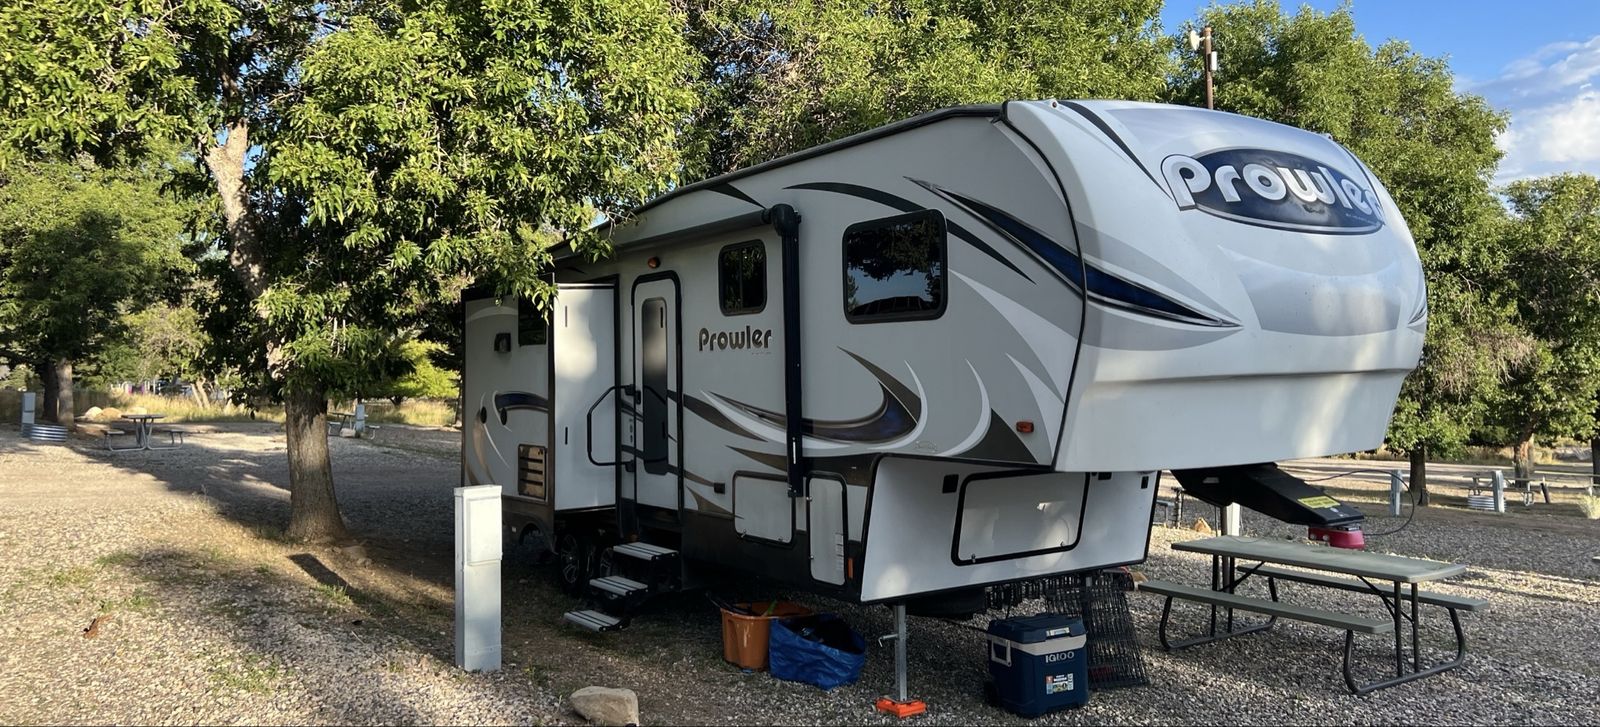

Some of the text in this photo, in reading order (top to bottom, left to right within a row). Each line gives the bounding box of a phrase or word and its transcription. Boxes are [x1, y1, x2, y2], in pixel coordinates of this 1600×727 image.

[1161, 154, 1384, 222] Prowler
[699, 325, 772, 351] Prowler
[1045, 651, 1074, 663] IGLOO
